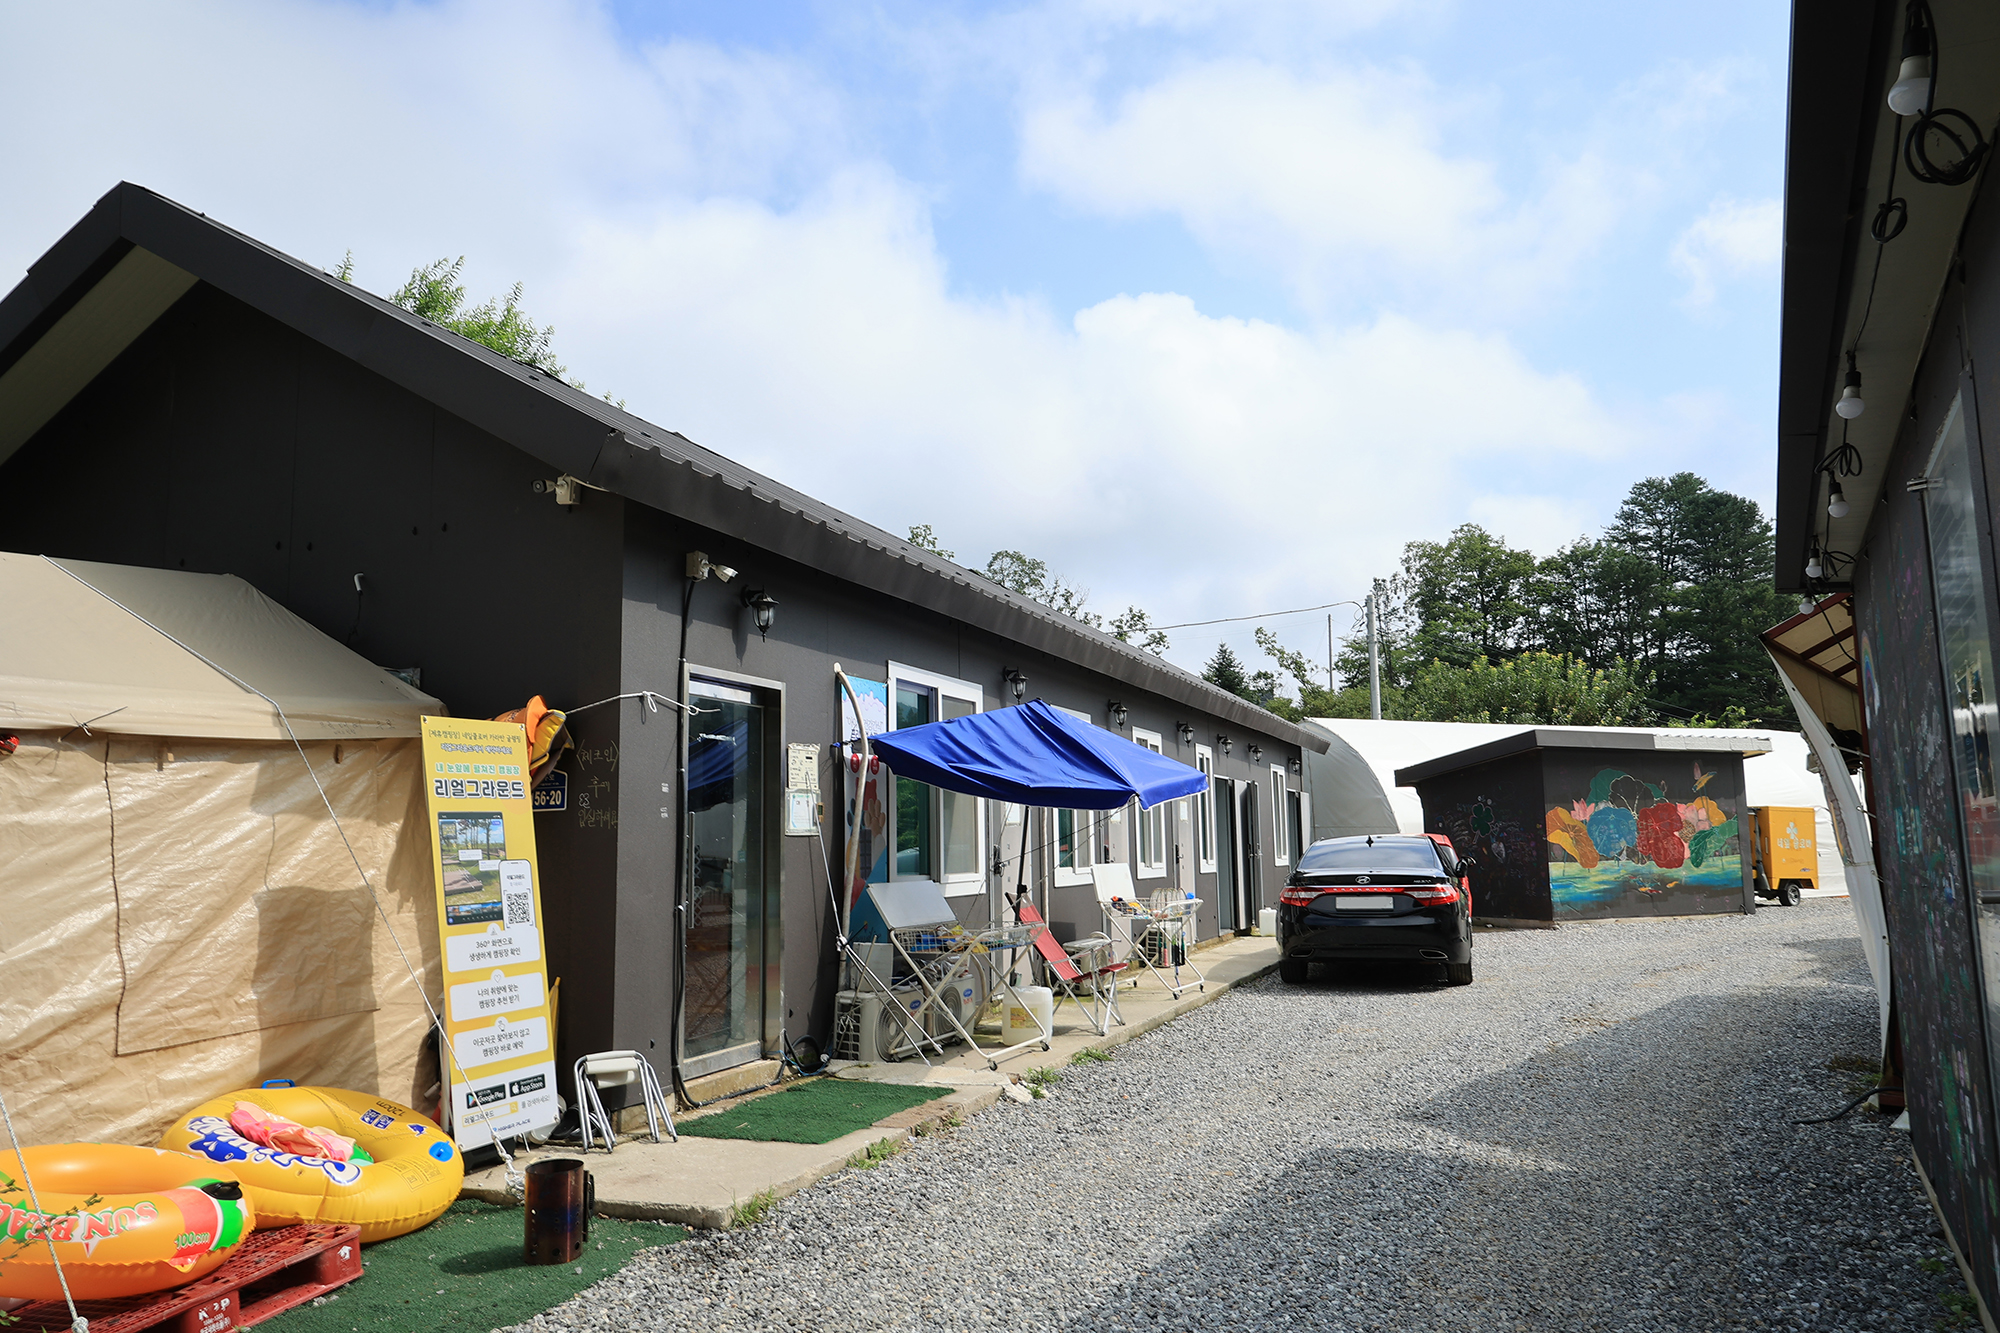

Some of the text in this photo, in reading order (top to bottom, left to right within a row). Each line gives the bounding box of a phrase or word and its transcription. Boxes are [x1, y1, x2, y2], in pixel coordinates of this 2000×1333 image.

[435, 762, 520, 775] 내 눈앞에 펼쳐진 캠핑장
[434, 778, 525, 799] 리얼그라운드
[532, 790, 562, 806] 56-20
[491, 937, 513, 948] 화면으로
[469, 947, 521, 962] 생생하게 캠핑장 확인
[477, 984, 519, 997] 나의 취향에 맞는
[478, 994, 520, 1009] 캠핑장 추천 받기
[473, 1028, 530, 1047] 이곳저곳 찾아보지 않고
[482, 1040, 524, 1058] 캠핑장 바로 예약
[520, 1081, 544, 1093] App Store
[494, 1091, 505, 1101] Play
[82, 1201, 159, 1242] SUN
[174, 1232, 210, 1250] 100cm
